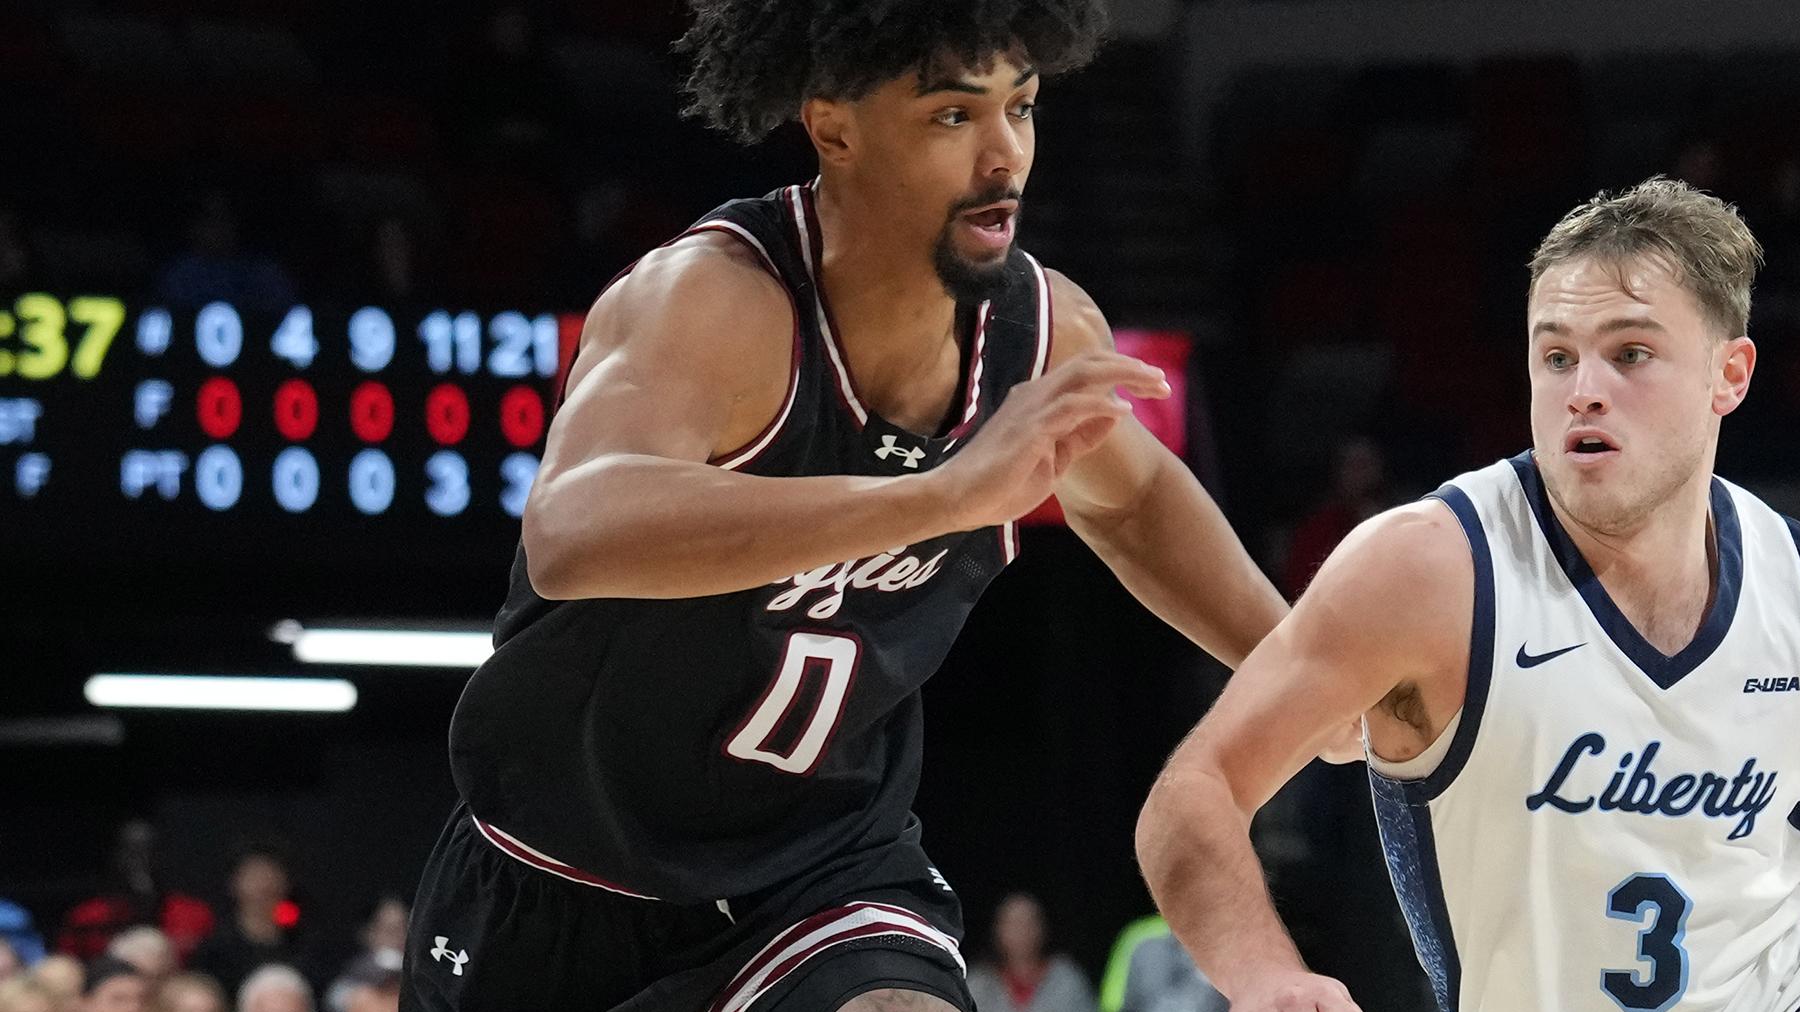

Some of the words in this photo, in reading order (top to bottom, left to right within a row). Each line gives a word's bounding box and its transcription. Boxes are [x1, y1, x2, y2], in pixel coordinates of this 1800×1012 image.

[195, 301, 243, 368] 0
[270, 305, 319, 368] 4
[348, 306, 396, 372] 9
[417, 311, 482, 375] 11
[487, 311, 559, 376] 21
[198, 377, 242, 438] 0
[275, 380, 318, 440] 0
[351, 382, 394, 442] 0
[427, 384, 470, 444] 0
[501, 387, 544, 447] 0
[195, 444, 243, 511] 0
[272, 447, 320, 512] 0
[348, 448, 396, 515] 0
[425, 450, 471, 516] 3
[766, 545, 949, 620] ggies
[723, 630, 861, 776] 0
[1525, 732, 1778, 840] Liberty
